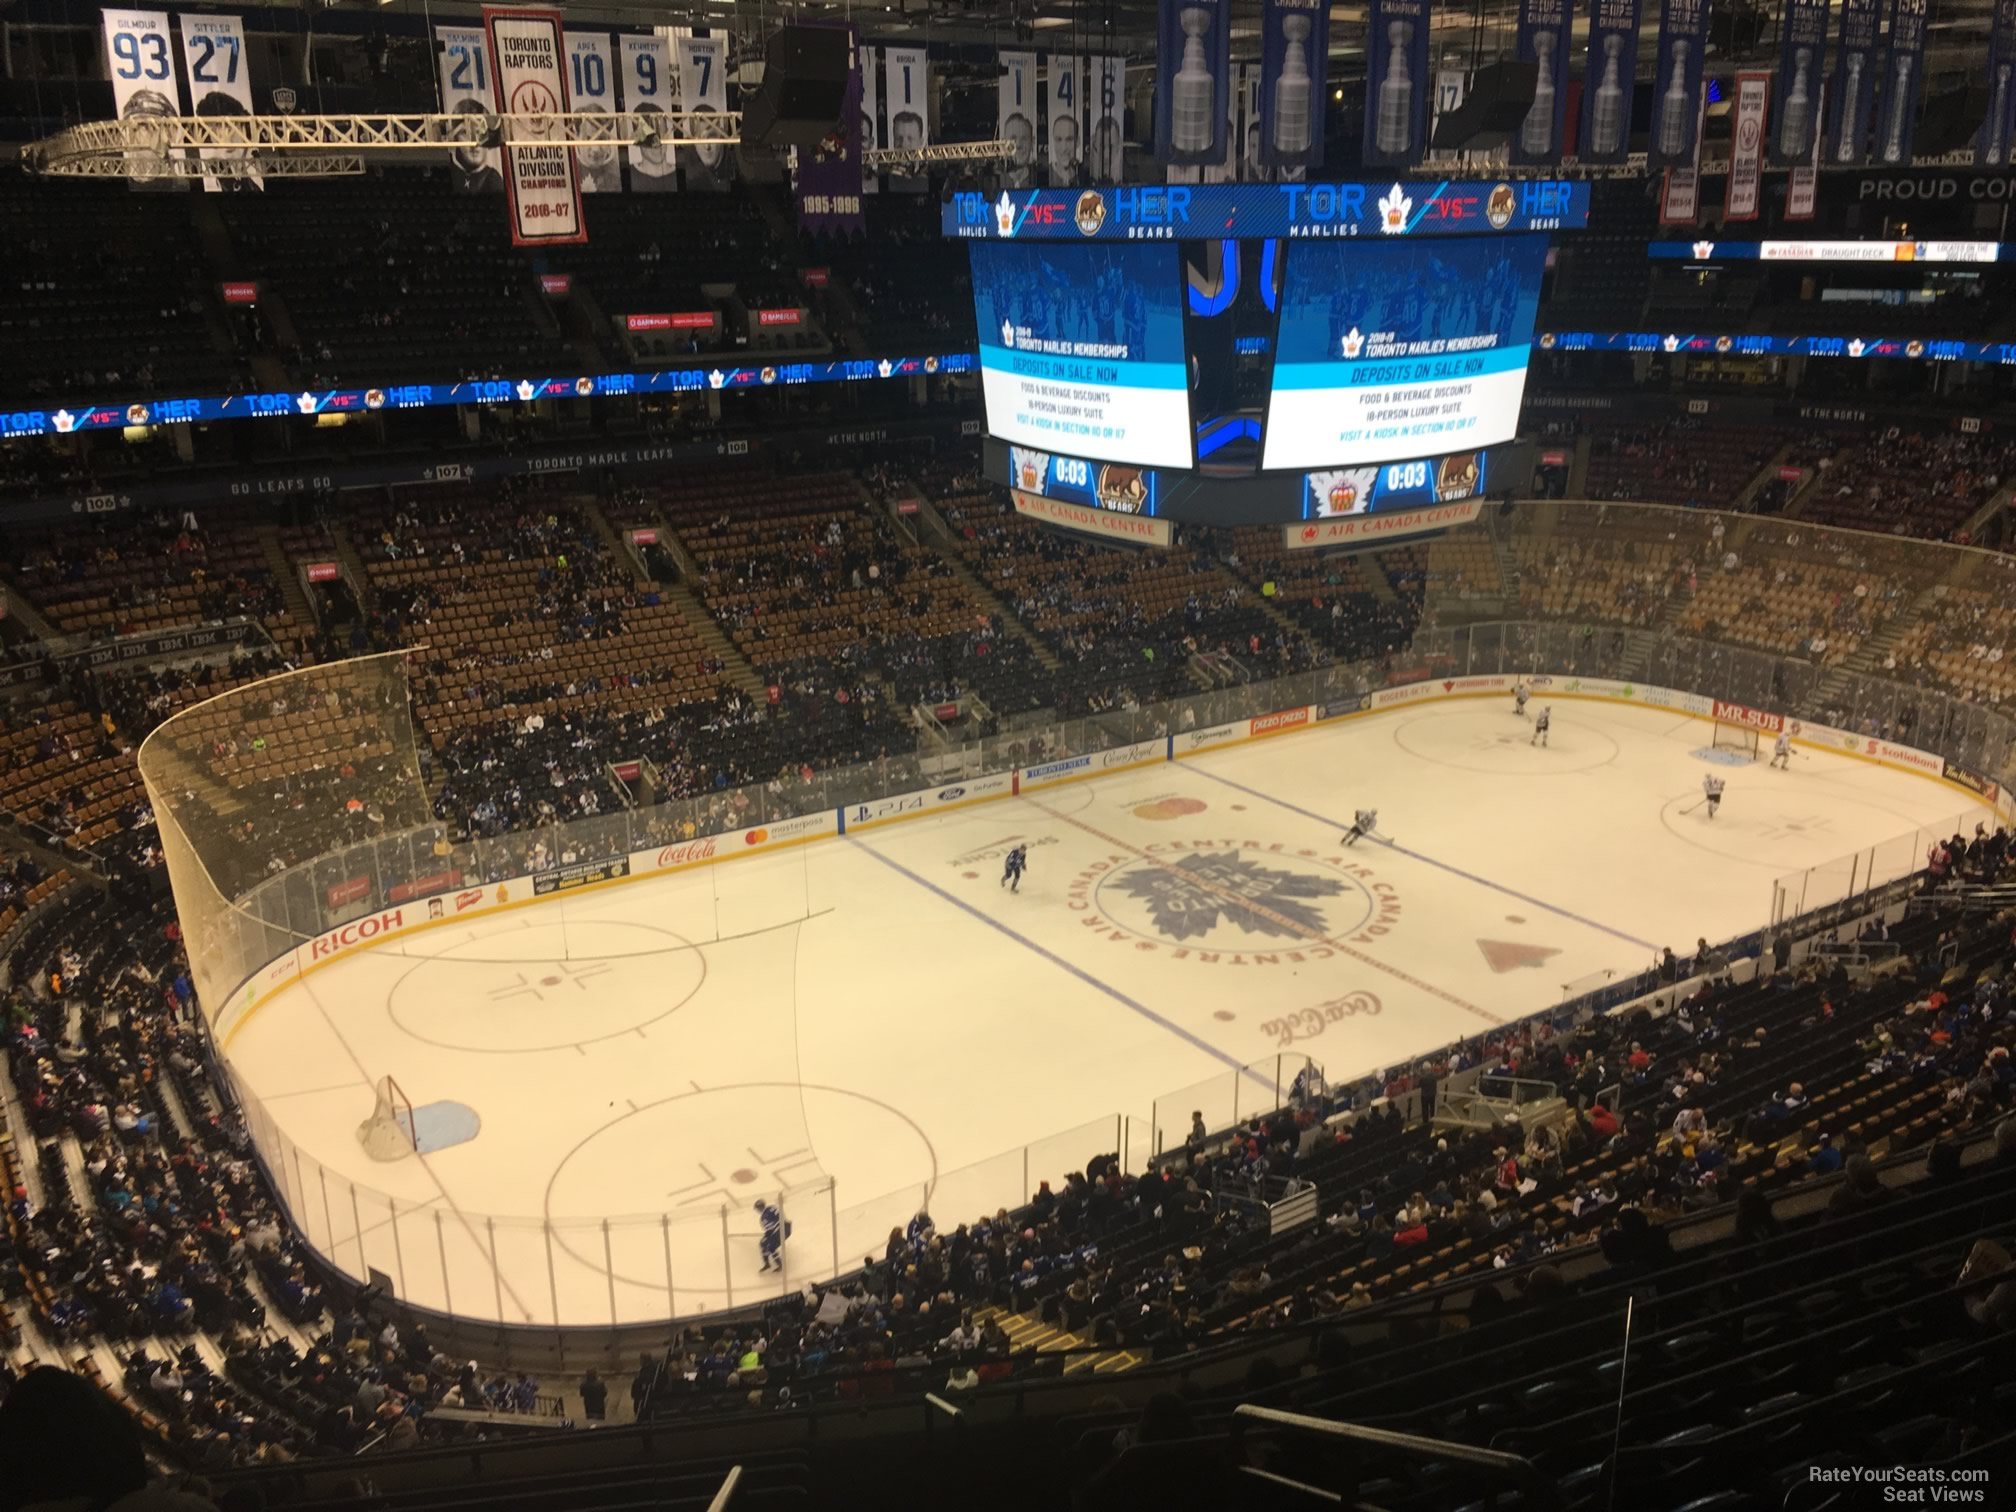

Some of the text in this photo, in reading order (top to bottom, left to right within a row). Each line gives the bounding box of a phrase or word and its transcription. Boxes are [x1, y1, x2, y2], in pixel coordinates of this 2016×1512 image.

[1380, 1, 1422, 16] CHAMPIONS
[118, 19, 157, 29] GILMOUR
[194, 23, 231, 33] SITTLER
[503, 37, 551, 52] TORONTO
[113, 32, 170, 80] 93
[189, 35, 240, 83] 27
[504, 54, 553, 69] RAPTORS
[448, 46, 485, 90] 21
[572, 53, 606, 97] 10
[636, 53, 657, 96] 9
[692, 55, 712, 97] 7
[903, 66, 911, 104] 1
[1015, 69, 1022, 106] 1
[1058, 72, 1073, 107] 4
[1439, 86, 1459, 111] 17
[518, 146, 563, 160] ATLANTIC
[519, 162, 565, 177] DIVISION
[521, 179, 567, 189] CHAMPIONS
[1859, 179, 1957, 200] PROUD
[1032, 204, 1053, 224] VS
[1115, 187, 1191, 224] HER
[1280, 182, 1572, 221] TOR VS HER
[1128, 227, 1173, 238] BEARS
[1290, 224, 1359, 237] MARLIES
[1530, 218, 1560, 230] BEARS
[1016, 337, 1128, 359] TORONTO MARLIES MEMBERSHIPS
[1365, 333, 1498, 358] TORONTO MARLIES MEMBERSHIPS
[1560, 333, 1594, 345] HER
[1626, 333, 1660, 345] TOR
[1736, 335, 1773, 349] HER
[1807, 337, 1844, 351] TOR
[1928, 340, 1967, 355] HER
[669, 370, 704, 385] TOR
[779, 364, 813, 379] HER
[842, 360, 874, 375] TOR
[941, 354, 972, 369] HER
[1013, 357, 1118, 382] DEPOSITS ON SALE NOW
[1352, 357, 1485, 383] DEPOSITS ON SALE NOW
[471, 381, 511, 397] TOR
[597, 374, 635, 390] HER
[1073, 389, 1111, 403] DISCOUNTS
[1360, 393, 1382, 404] FOOD
[1392, 387, 1432, 403] BEVERAGE
[1434, 383, 1472, 400] DISCOUNTS
[244, 393, 290, 410] TOR
[389, 385, 432, 403] HER
[0, 399, 201, 432] TOR VS HER
[1057, 403, 1104, 420] LUXURY SUITE
[1367, 401, 1462, 422] 18-PERSON LUXURY SUITE
[1340, 429, 1362, 441] VISIT
[1373, 426, 1399, 439] KIOSK
[1411, 421, 1443, 436] SECTION
[527, 448, 673, 470] TORONTO MAPLE LEAFS
[438, 466, 459, 478] 107
[1056, 459, 1087, 486] 0:03
[1388, 462, 1425, 491] 0:03
[231, 476, 331, 495] GO LEAFS GO
[1030, 500, 1155, 537] AIR CANADA CENTRE
[1327, 504, 1473, 537] AIR CANADA CENTRE
[158, 638, 183, 652] IBM
[192, 632, 216, 645] IBM
[1379, 685, 1431, 702] ROGERS TV
[1253, 710, 1306, 735] pizza pizza
[1881, 745, 1938, 771] Scotiabank
[878, 796, 922, 816] PS4
[771, 817, 824, 834] masterpass
[1067, 853, 1132, 943] AIR CANADA
[1351, 882, 1402, 945] CANADA
[310, 909, 403, 960] RICOH
[1170, 947, 1336, 966] CENTRE
